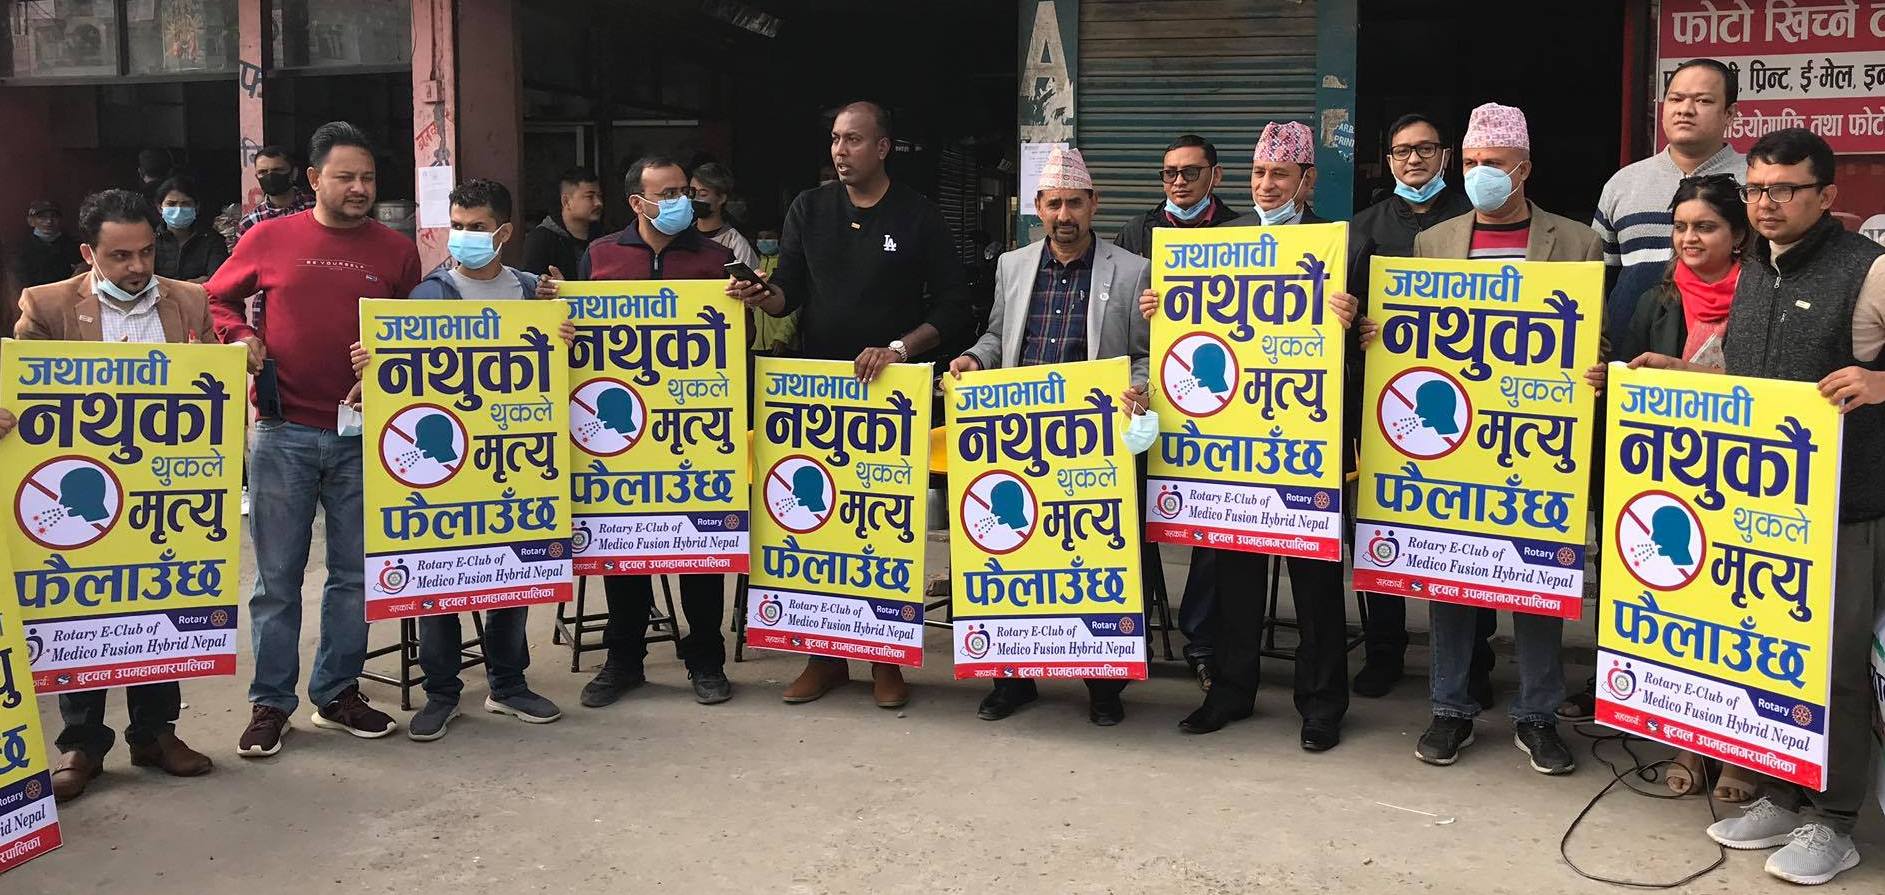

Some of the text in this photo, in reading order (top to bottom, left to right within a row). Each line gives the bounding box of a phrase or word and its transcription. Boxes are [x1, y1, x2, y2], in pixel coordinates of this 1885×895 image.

[1672, 0, 1754, 44] फोटो
[1164, 233, 1276, 269] जथाभावी
[1384, 265, 1523, 302] जथाभावी
[375, 307, 501, 341] जथाभावी
[1262, 328, 1324, 364] थुकले
[18, 350, 171, 386] जथाभावी
[668, 372, 729, 405] थुकले
[956, 370, 1066, 411] जथाभावी
[1243, 368, 1328, 422] मृत्यु
[1500, 372, 1576, 407] थुकले
[1620, 384, 1754, 427] जथाभावी
[490, 395, 552, 430] थुकले
[651, 408, 735, 454] मृत्यु
[1159, 420, 1327, 478] फैलाउँछ
[1476, 410, 1578, 474] मृत्यु
[151, 448, 225, 485] थुकले
[473, 432, 559, 483] मृत्यु
[856, 457, 912, 488] थुकले
[572, 459, 735, 504] फैलाउँछ
[1057, 459, 1118, 496] थुकले
[381, 487, 559, 542] फैलाउँछ
[1190, 489, 1271, 508] Rotary E-Club of
[1286, 493, 1312, 504] Rotary
[1374, 460, 1575, 533] फैलाउँछ
[128, 489, 228, 544] मृत्यु
[599, 522, 683, 534] Rotary E-Club of
[698, 518, 722, 526] Rotary
[839, 490, 915, 543] मृत्यु
[1042, 498, 1125, 552] मृत्यु
[1189, 506, 1329, 532] Medico Fusion Hybrid Nepal
[1733, 507, 1809, 545] थुकले
[521, 547, 546, 556] Rotary
[599, 536, 739, 551] Medico Fusion Hybrid Nepal
[1408, 537, 1506, 561] Rotary E-Club of
[1524, 546, 1554, 559] Rotary
[15, 548, 226, 608] फैलाउँछ
[416, 564, 564, 589] Medico Fusion Hybrid Nepal
[417, 554, 506, 571] Rotary E-Club of
[762, 535, 914, 594] फैलाउँछ
[963, 555, 1127, 606] फैलाउँछ
[1406, 553, 1574, 591] Medico Fusion Hybrid Nepal
[1712, 541, 1813, 622] मृत्यु
[178, 615, 208, 625] Rotary
[789, 600, 863, 618] Rotary E-Club of
[876, 606, 899, 615] Rotary
[1092, 621, 1116, 630] Rotary
[53, 622, 160, 642] Rotary E-Club of
[788, 614, 914, 641] Medico Fusion Hybrid Nepal
[997, 625, 1077, 638] Rotary E-Club of
[1613, 591, 1811, 689] फैलाउँछ
[51, 634, 227, 662] Medico Fusion Hybrid Nepal
[997, 641, 1135, 657] Medico Fusion Hybrid Nepal
[1644, 671, 1740, 710] Rotary E-Club of
[1758, 698, 1790, 717] Rotary
[1643, 689, 1810, 752] Medico Fusion Hybrid Nepal
[14, 804, 46, 831] Nepal
